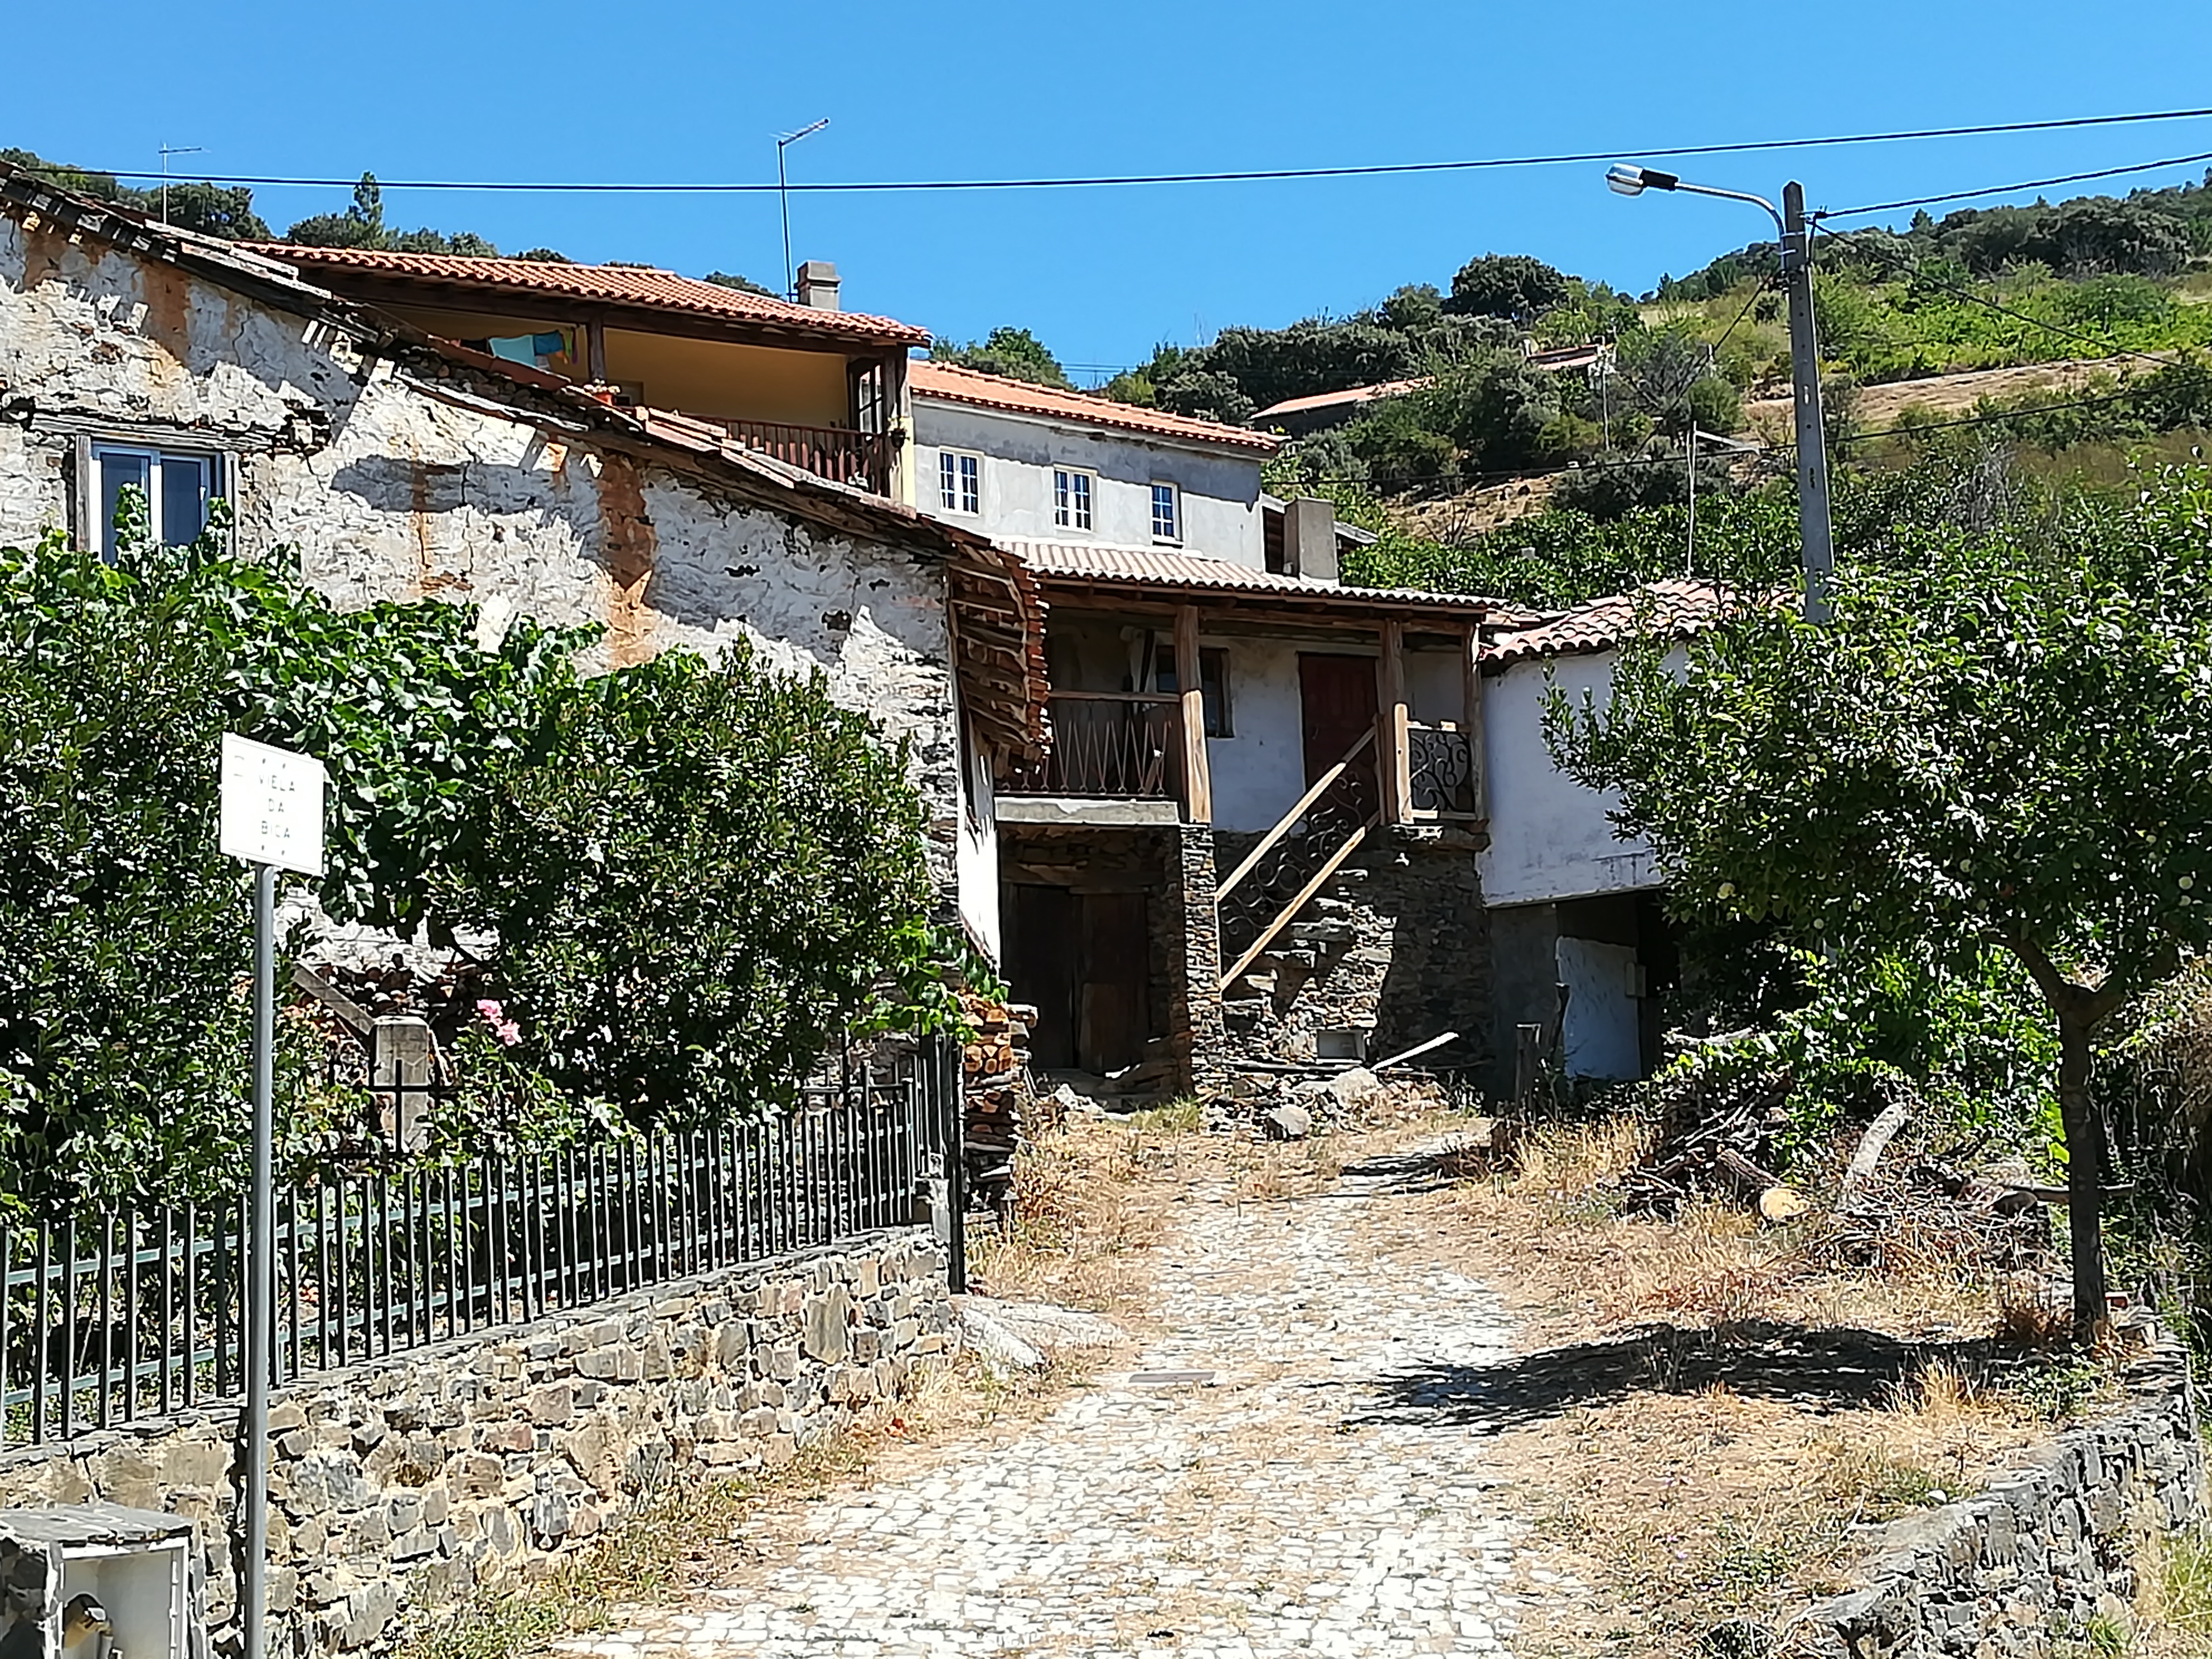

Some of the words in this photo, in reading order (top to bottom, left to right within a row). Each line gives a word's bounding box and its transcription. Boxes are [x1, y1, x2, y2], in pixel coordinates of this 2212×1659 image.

[258, 774, 295, 792] VIELA
[268, 798, 284, 813] DA
[261, 820, 290, 838] BICA
